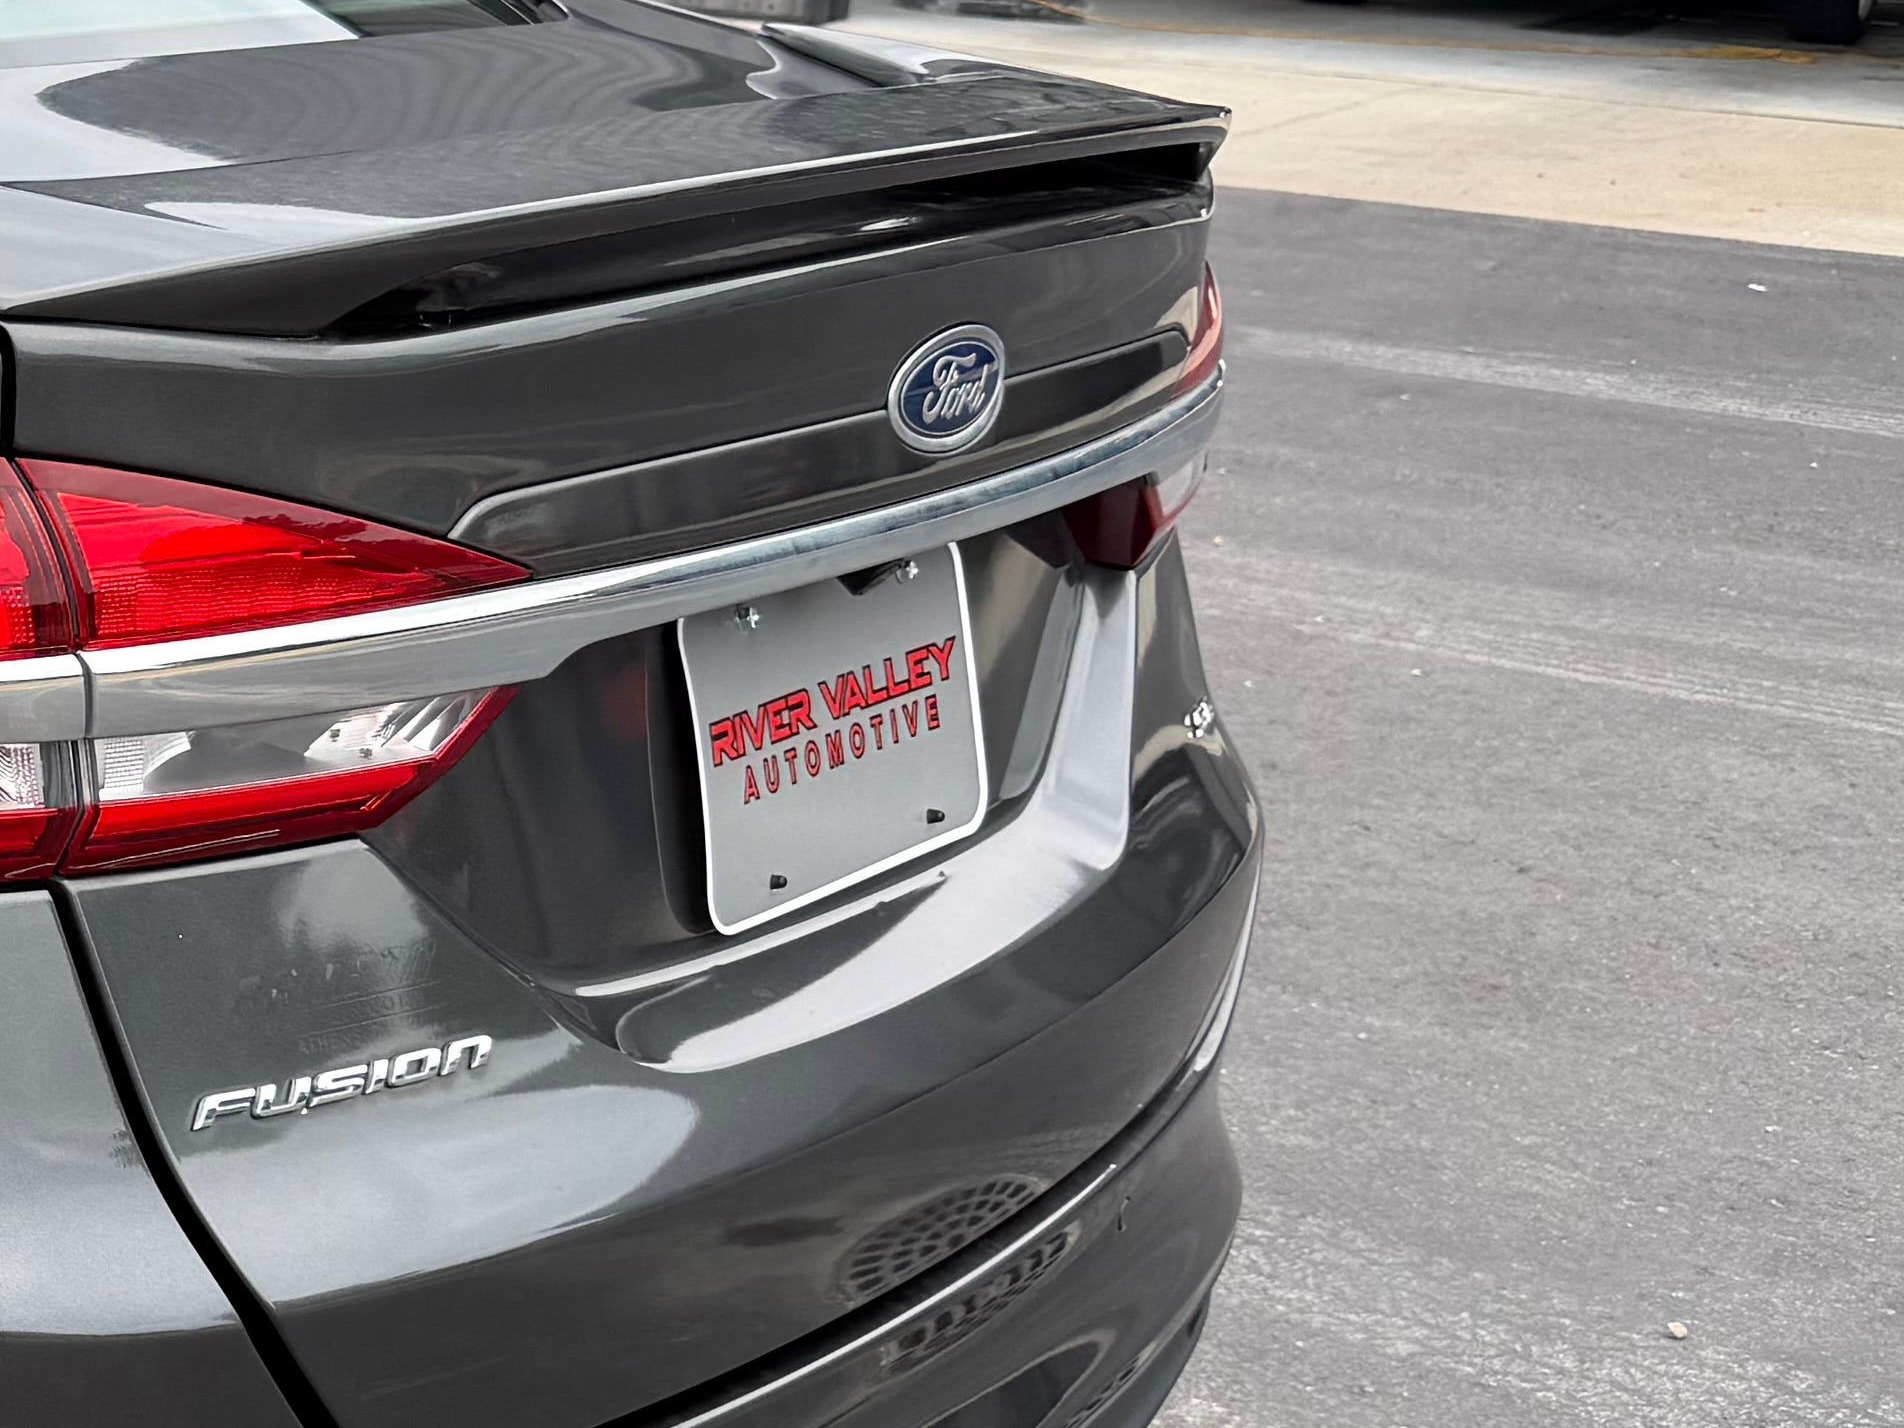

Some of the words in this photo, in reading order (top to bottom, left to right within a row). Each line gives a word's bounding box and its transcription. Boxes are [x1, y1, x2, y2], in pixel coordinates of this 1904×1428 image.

[922, 352, 993, 424] Ford
[708, 688, 818, 768] RIVER
[817, 635, 957, 721] VALLEY
[742, 693, 942, 805] AUTOMOTIVE
[190, 1033, 493, 1132] FUSION
